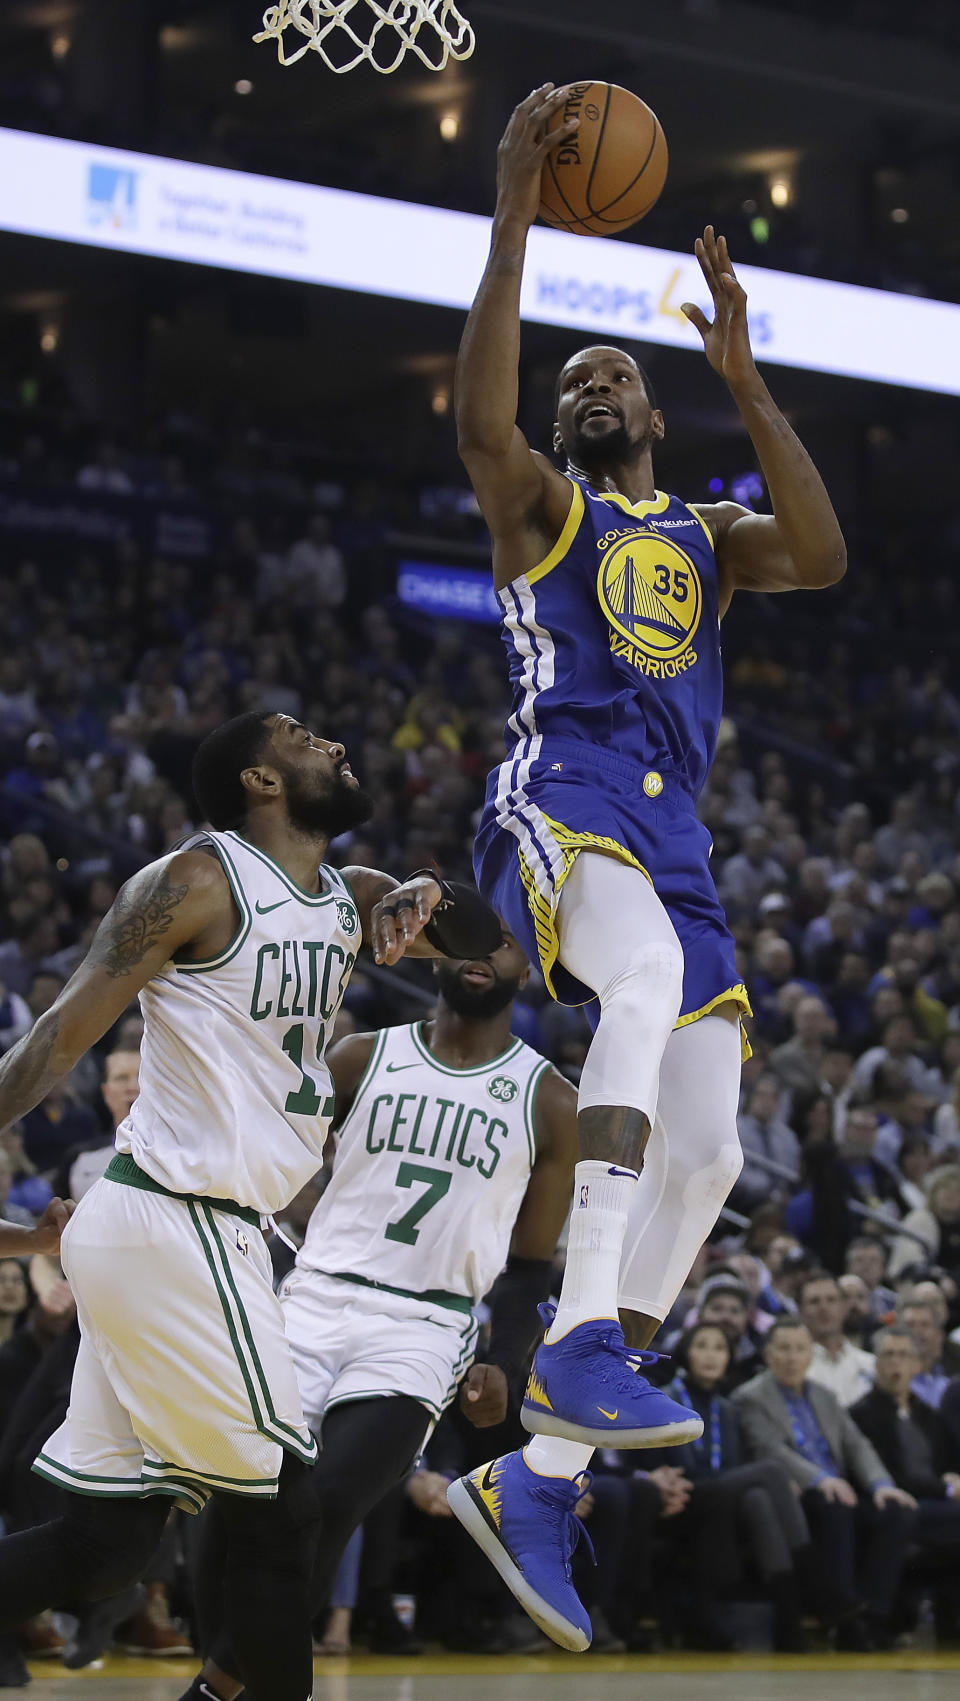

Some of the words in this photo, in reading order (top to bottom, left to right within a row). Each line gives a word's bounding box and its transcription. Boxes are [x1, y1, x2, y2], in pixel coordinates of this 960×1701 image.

[537, 272, 651, 323] HOOPS
[651, 519, 698, 529] Rakuten
[398, 574, 484, 611] CHASE
[653, 564, 689, 602] 35
[609, 627, 698, 679] WARRIORS
[366, 1094, 509, 1179] CELTICS
[384, 1161, 453, 1246] 7
